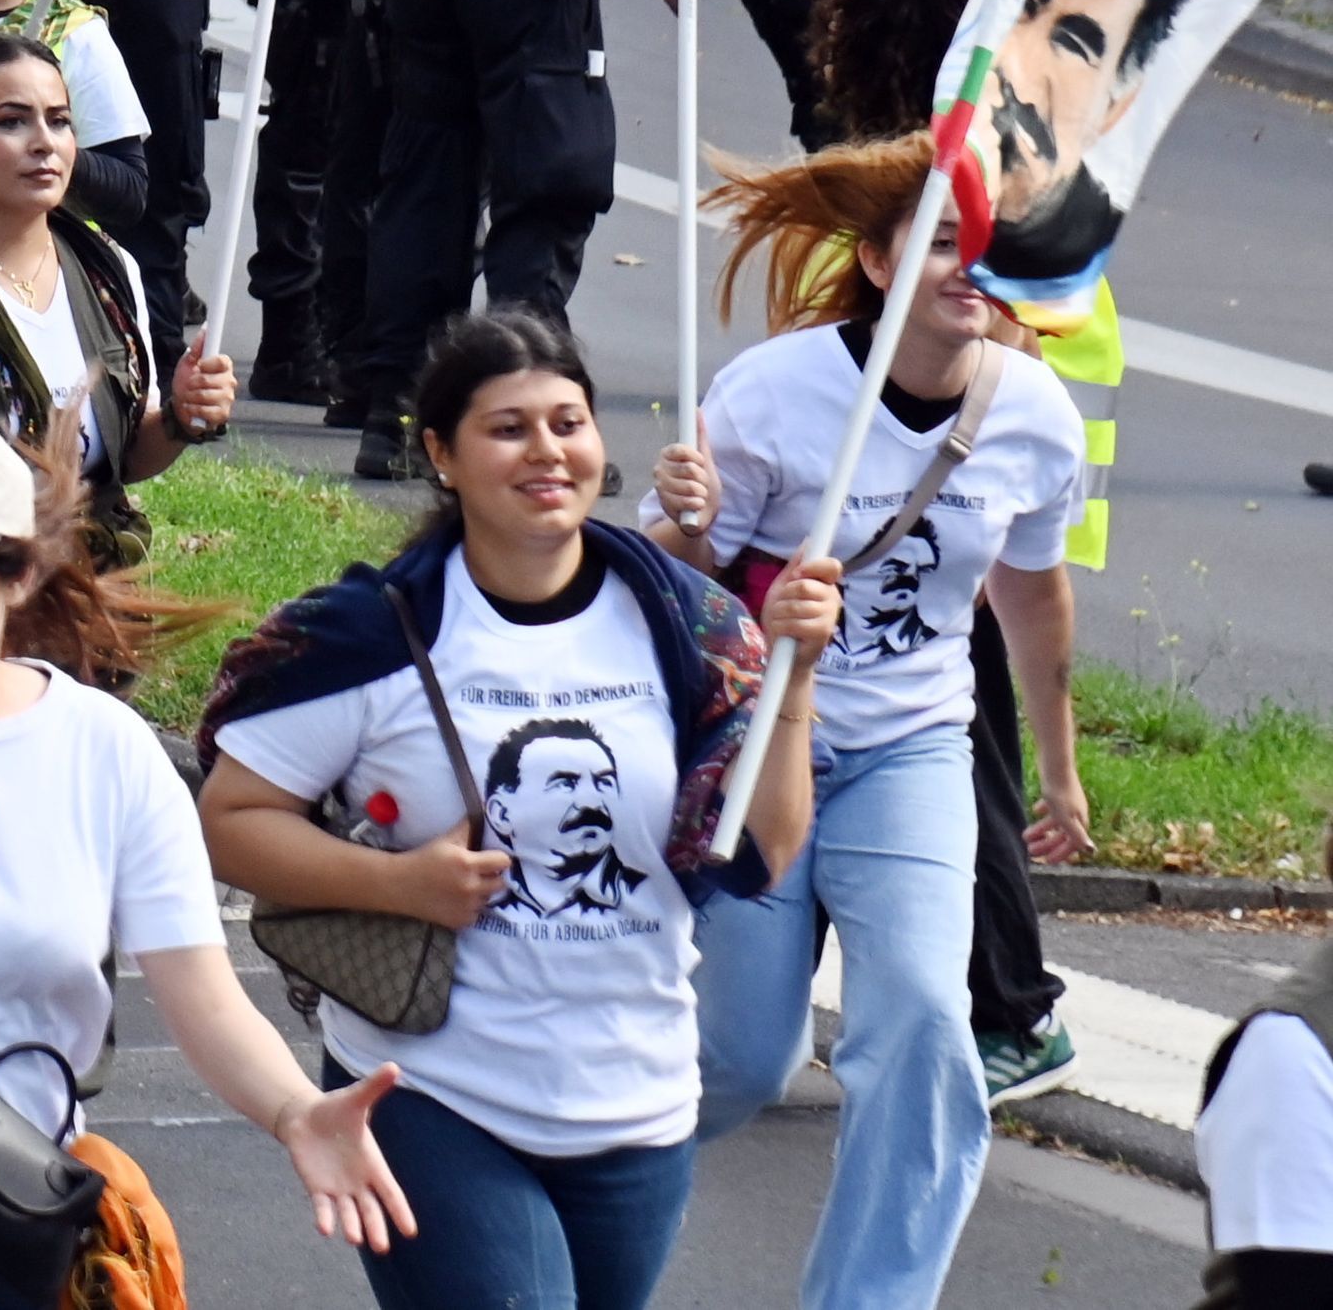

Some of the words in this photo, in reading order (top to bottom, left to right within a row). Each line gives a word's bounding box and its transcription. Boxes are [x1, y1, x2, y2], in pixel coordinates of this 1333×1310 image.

[862, 492, 902, 510] FREIHEIT
[460, 685, 483, 703] FÜR
[488, 688, 540, 708] FREIHEIT
[545, 690, 571, 708] UND
[575, 681, 655, 705] DEMOKRATIE
[476, 915, 519, 938] REIHEIT
[523, 918, 549, 941] FÜR
[554, 922, 617, 942] ABDULLAH
[618, 916, 662, 936] ÖCALAN
